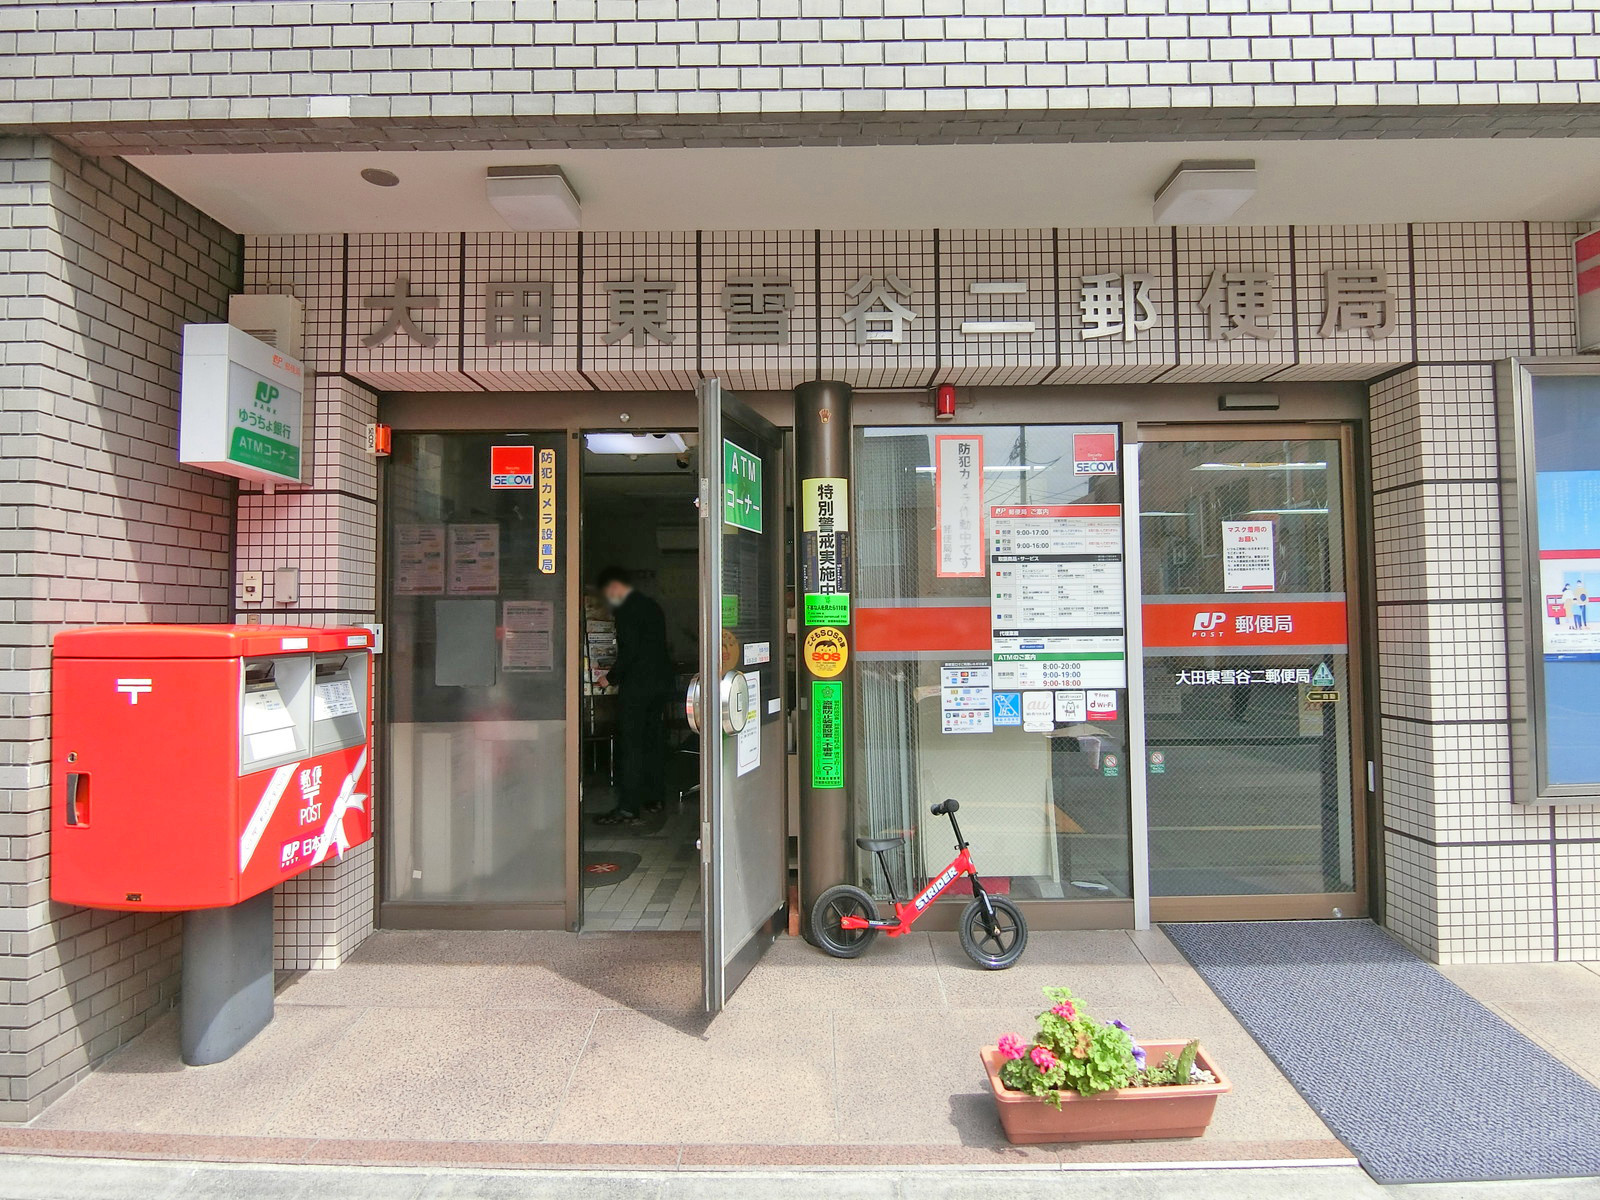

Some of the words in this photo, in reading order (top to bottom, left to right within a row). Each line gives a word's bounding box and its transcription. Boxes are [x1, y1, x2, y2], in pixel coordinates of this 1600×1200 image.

[361, 268, 1396, 350] 大田東雪谷二郵便局
[254, 401, 277, 415] BANK
[238, 408, 291, 440] ゆうちょ銀行
[239, 435, 296, 460] ATMコーナー
[732, 451, 756, 483] ATM
[1076, 462, 1114, 472] SECOM
[494, 475, 532, 485] SECOM
[540, 451, 554, 571] 防犯カメラ設置局
[727, 488, 761, 515] コーナー
[817, 483, 837, 595] 特別警戒実施中
[1235, 614, 1293, 634] 郵便局
[811, 652, 841, 662] SOS
[1175, 669, 1310, 686] 大田東雪谷二郵便局
[1027, 700, 1050, 711] au
[301, 765, 322, 791] 郵便
[301, 803, 322, 826] POST
[915, 866, 958, 911] STRIDER
